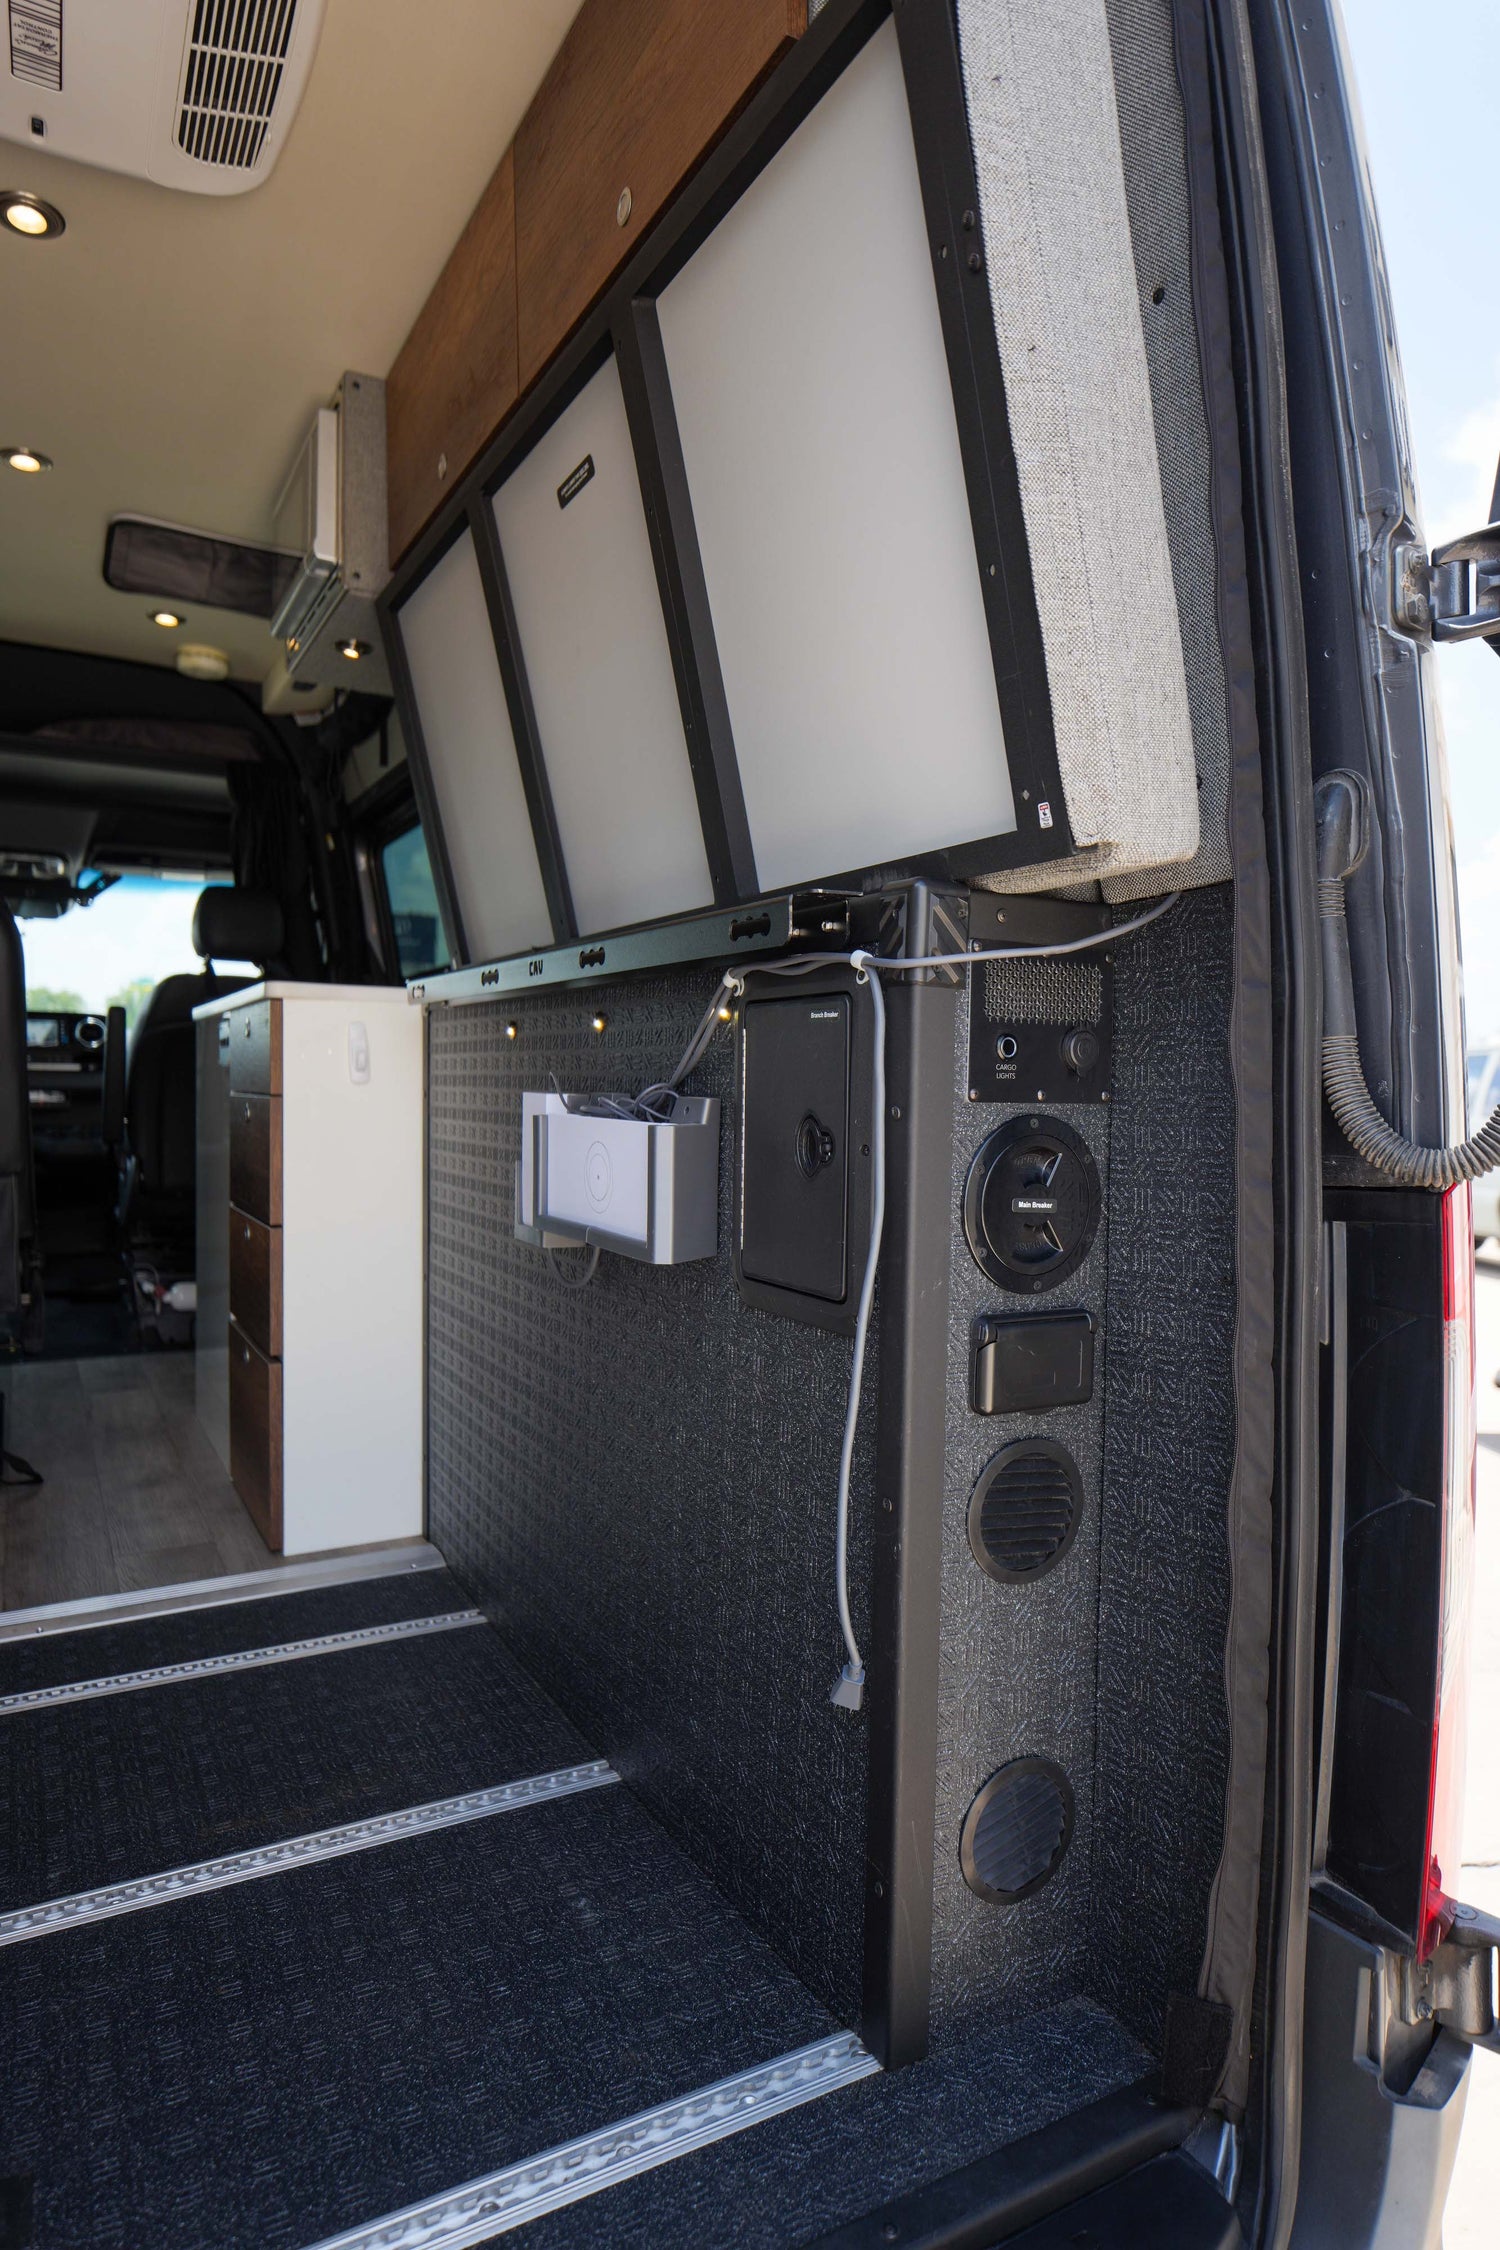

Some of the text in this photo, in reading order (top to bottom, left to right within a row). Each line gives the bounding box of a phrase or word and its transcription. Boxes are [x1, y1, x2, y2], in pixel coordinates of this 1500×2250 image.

[995, 1063, 1017, 1071] CARGO
[996, 1072, 1016, 1080] LIGHTS
[1018, 1200, 1053, 1209] Main Breaker
